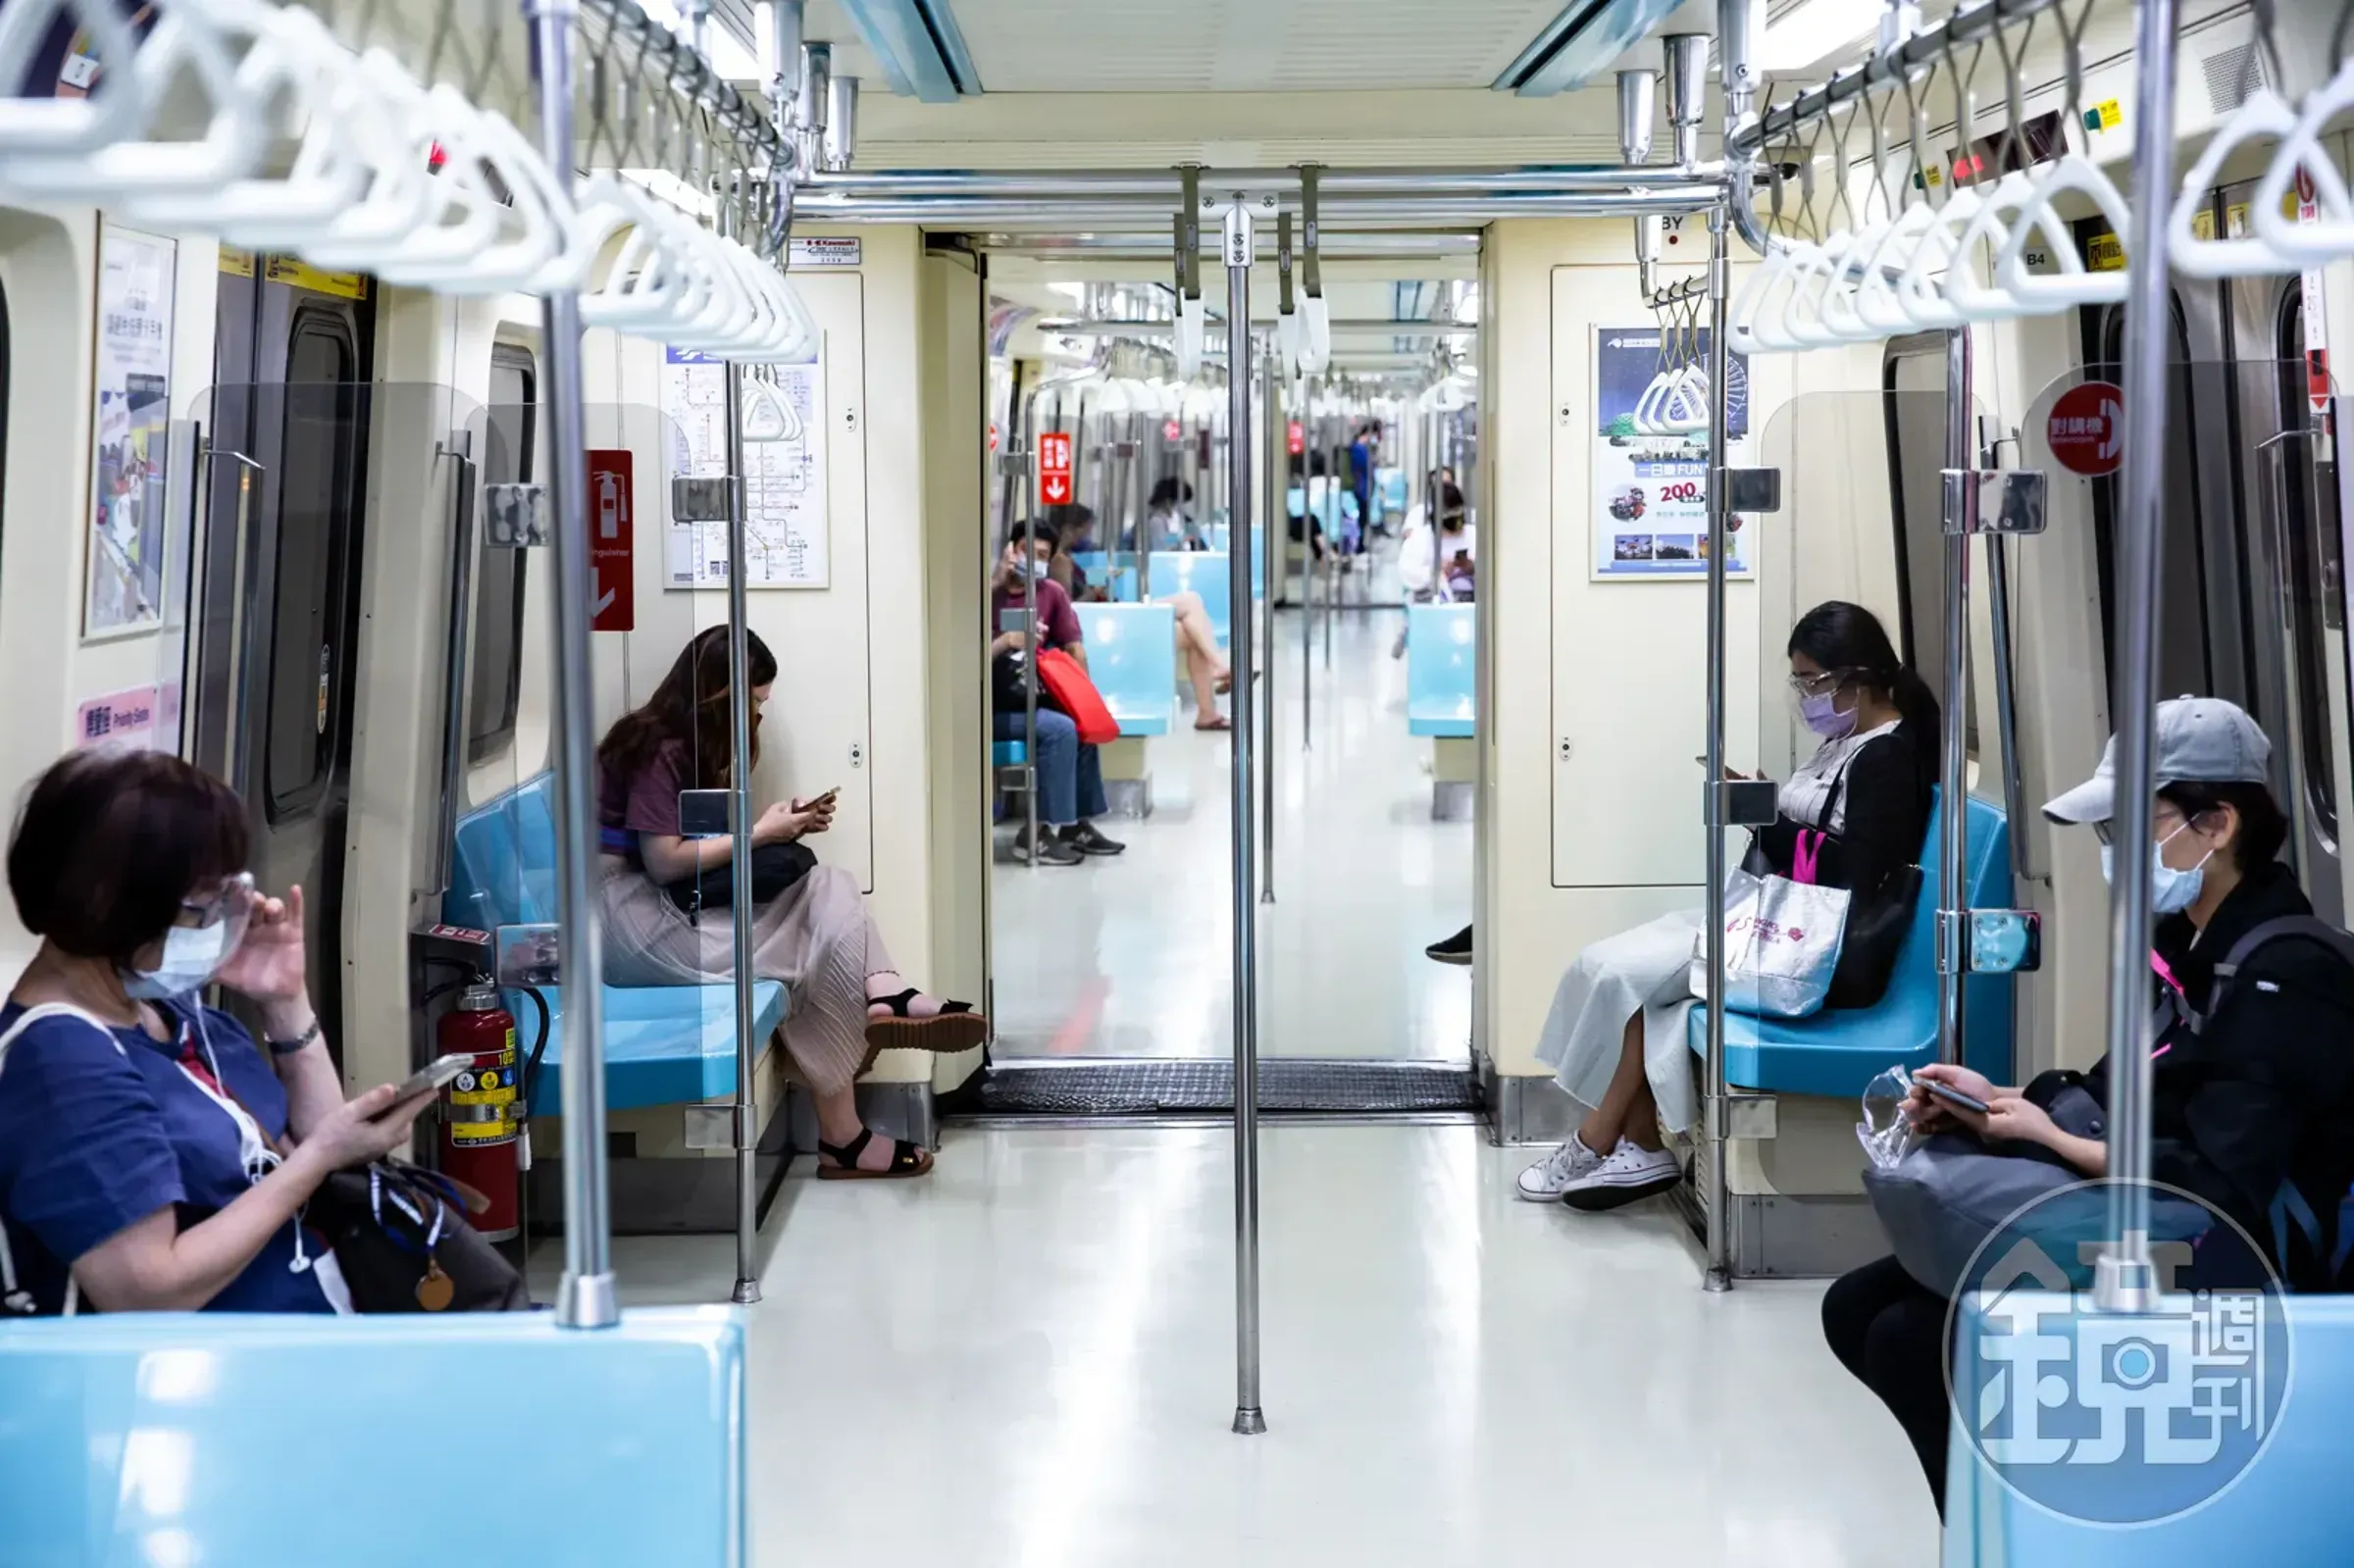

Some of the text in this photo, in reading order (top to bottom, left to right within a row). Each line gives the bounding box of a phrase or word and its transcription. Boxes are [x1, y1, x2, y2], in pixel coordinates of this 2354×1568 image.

[1662, 215, 1683, 230] BY
[2026, 253, 2046, 266] B4
[1660, 481, 1697, 502] 200
